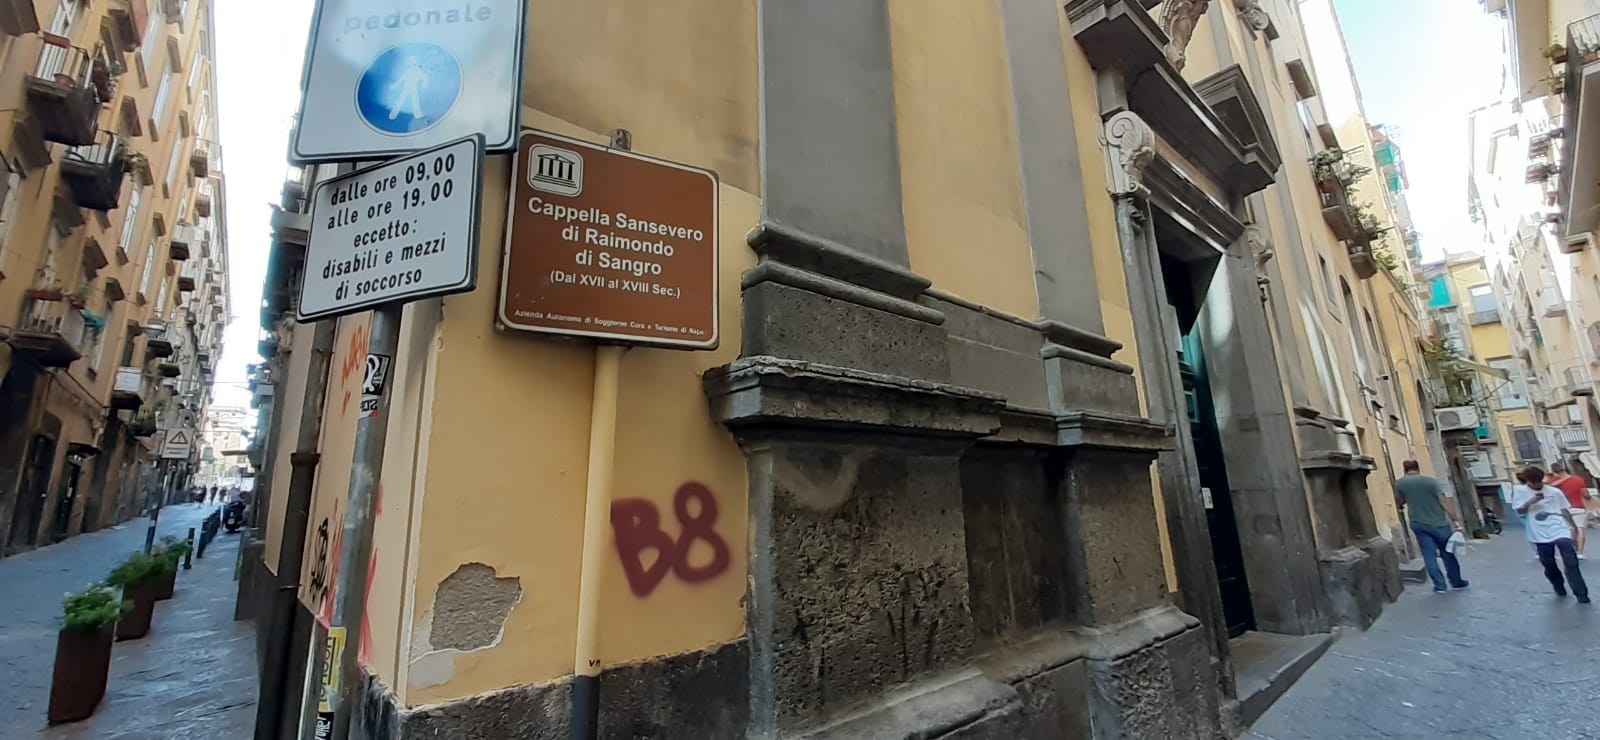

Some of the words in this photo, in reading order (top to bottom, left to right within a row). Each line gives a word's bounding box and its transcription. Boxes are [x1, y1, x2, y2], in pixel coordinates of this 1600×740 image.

[345, 5, 492, 35] pedonale
[331, 182, 368, 206] dalle
[374, 175, 397, 193] ore
[327, 207, 359, 230] alle
[367, 200, 392, 219] ore
[528, 196, 610, 226] Cappella
[615, 213, 704, 242] Sansevero
[353, 218, 418, 248] eccetto:
[562, 225, 579, 242] di
[585, 228, 674, 257] Raimondo
[322, 249, 378, 279] disabili
[384, 252, 393, 264] e
[400, 232, 446, 261] mezzi
[575, 249, 593, 266] di
[598, 251, 662, 276] Sangro
[335, 280, 349, 301] di
[355, 268, 422, 297] soccorso
[550, 270, 576, 284] (Dal
[579, 274, 604, 288] XVII
[608, 278, 618, 289] al
[622, 281, 649, 293] XVIII
[652, 283, 681, 299] Sec.)
[514, 309, 544, 319] Azienda
[546, 312, 582, 323] Autonoma
[594, 317, 627, 327] Soggiorno
[630, 321, 645, 329] Cura
[655, 323, 679, 333] Turismo
[681, 325, 687, 333] di
[610, 481, 731, 598] B8
